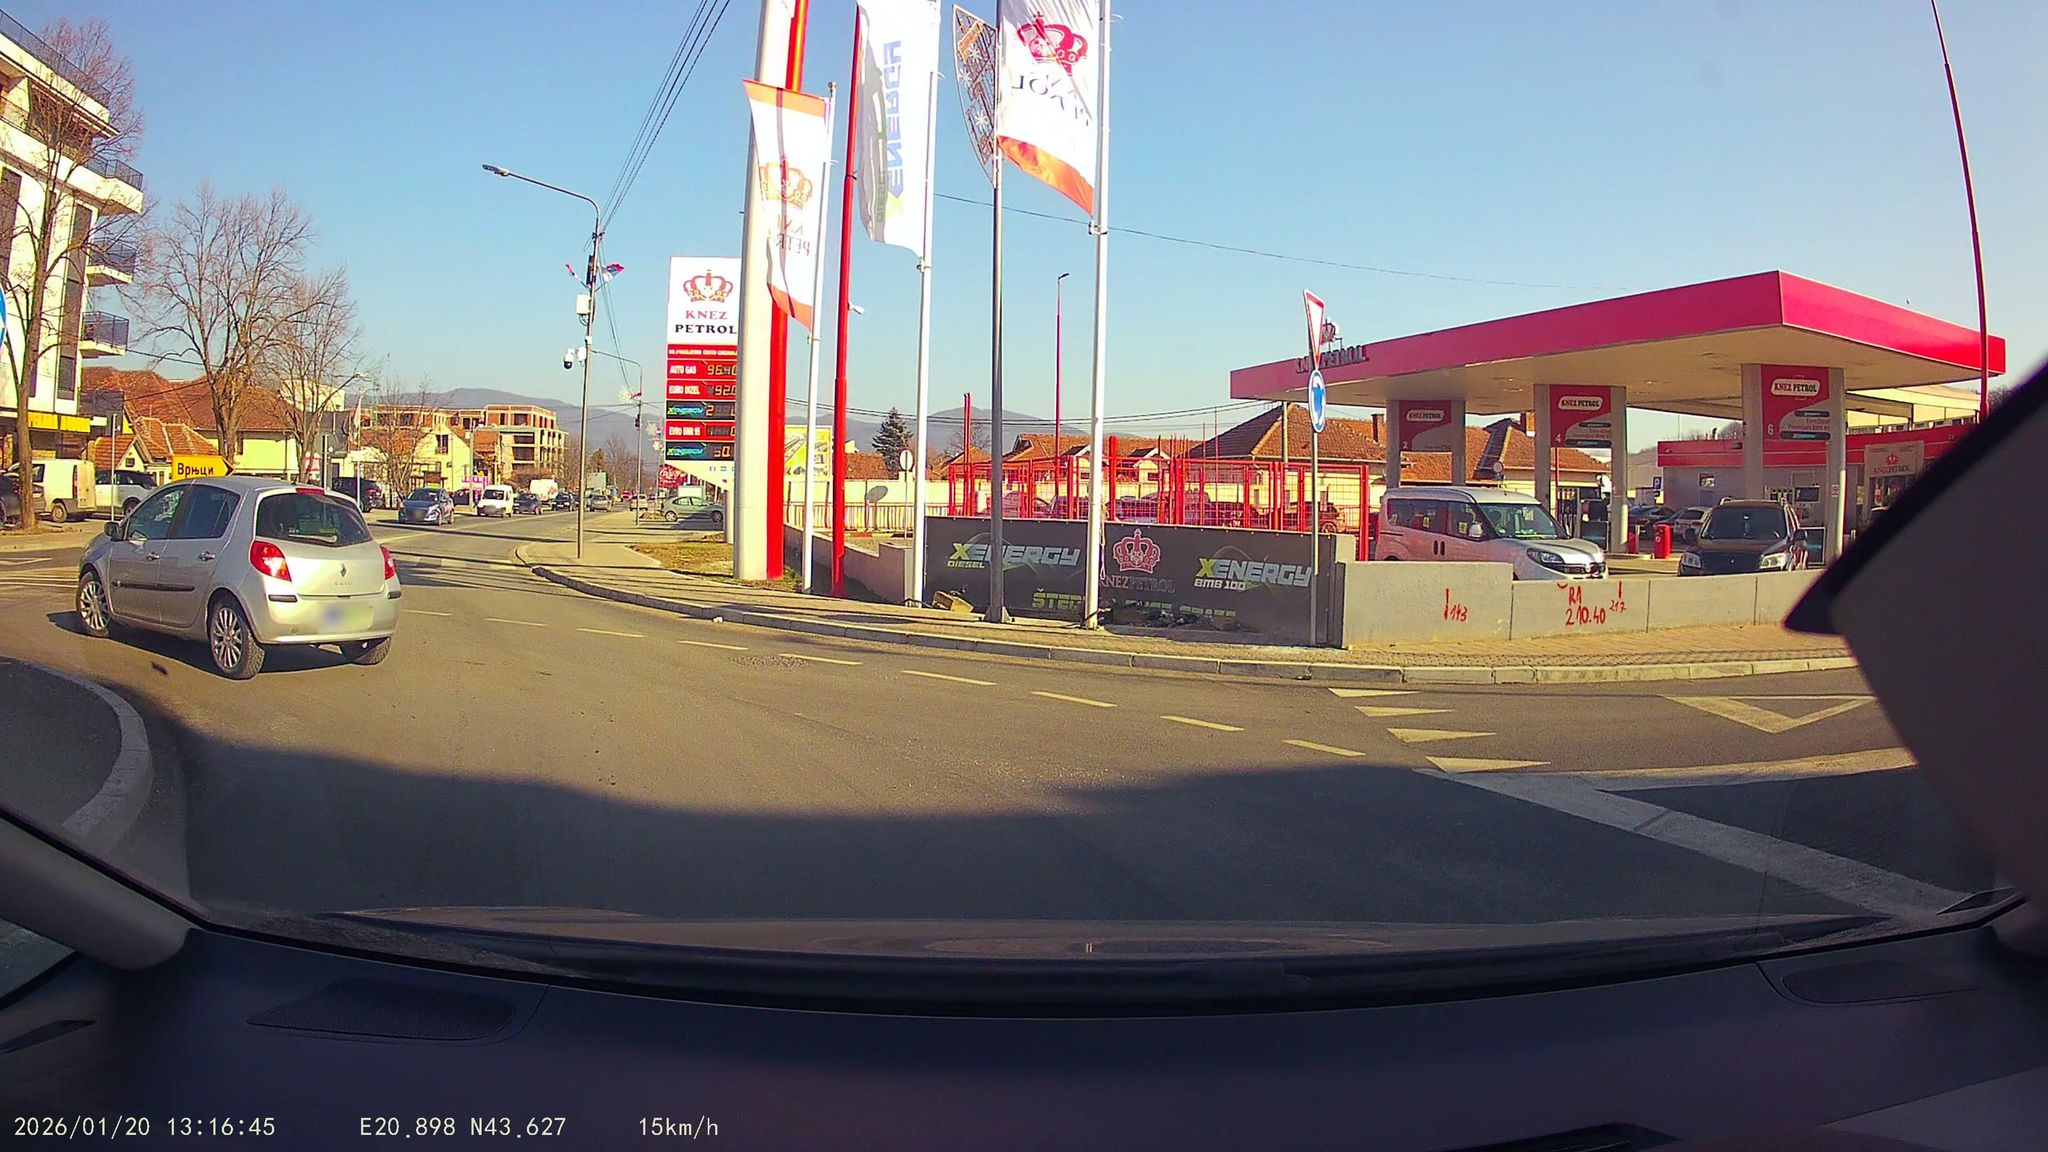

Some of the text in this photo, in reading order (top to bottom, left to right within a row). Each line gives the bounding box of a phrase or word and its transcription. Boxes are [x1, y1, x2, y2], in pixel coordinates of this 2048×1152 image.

[685, 310, 728, 320] KNEZ
[674, 324, 738, 335] PETROL
[1774, 383, 1817, 393] KNEZ PETROL
[1578, 400, 1600, 408] PETROL
[1767, 423, 1774, 435] 6
[177, 462, 214, 478] Врњци
[947, 561, 985, 569] DIESEL
[1196, 558, 1313, 587] XENERGY
[1224, 580, 1247, 591] 100
[1568, 585, 1582, 606] R1
